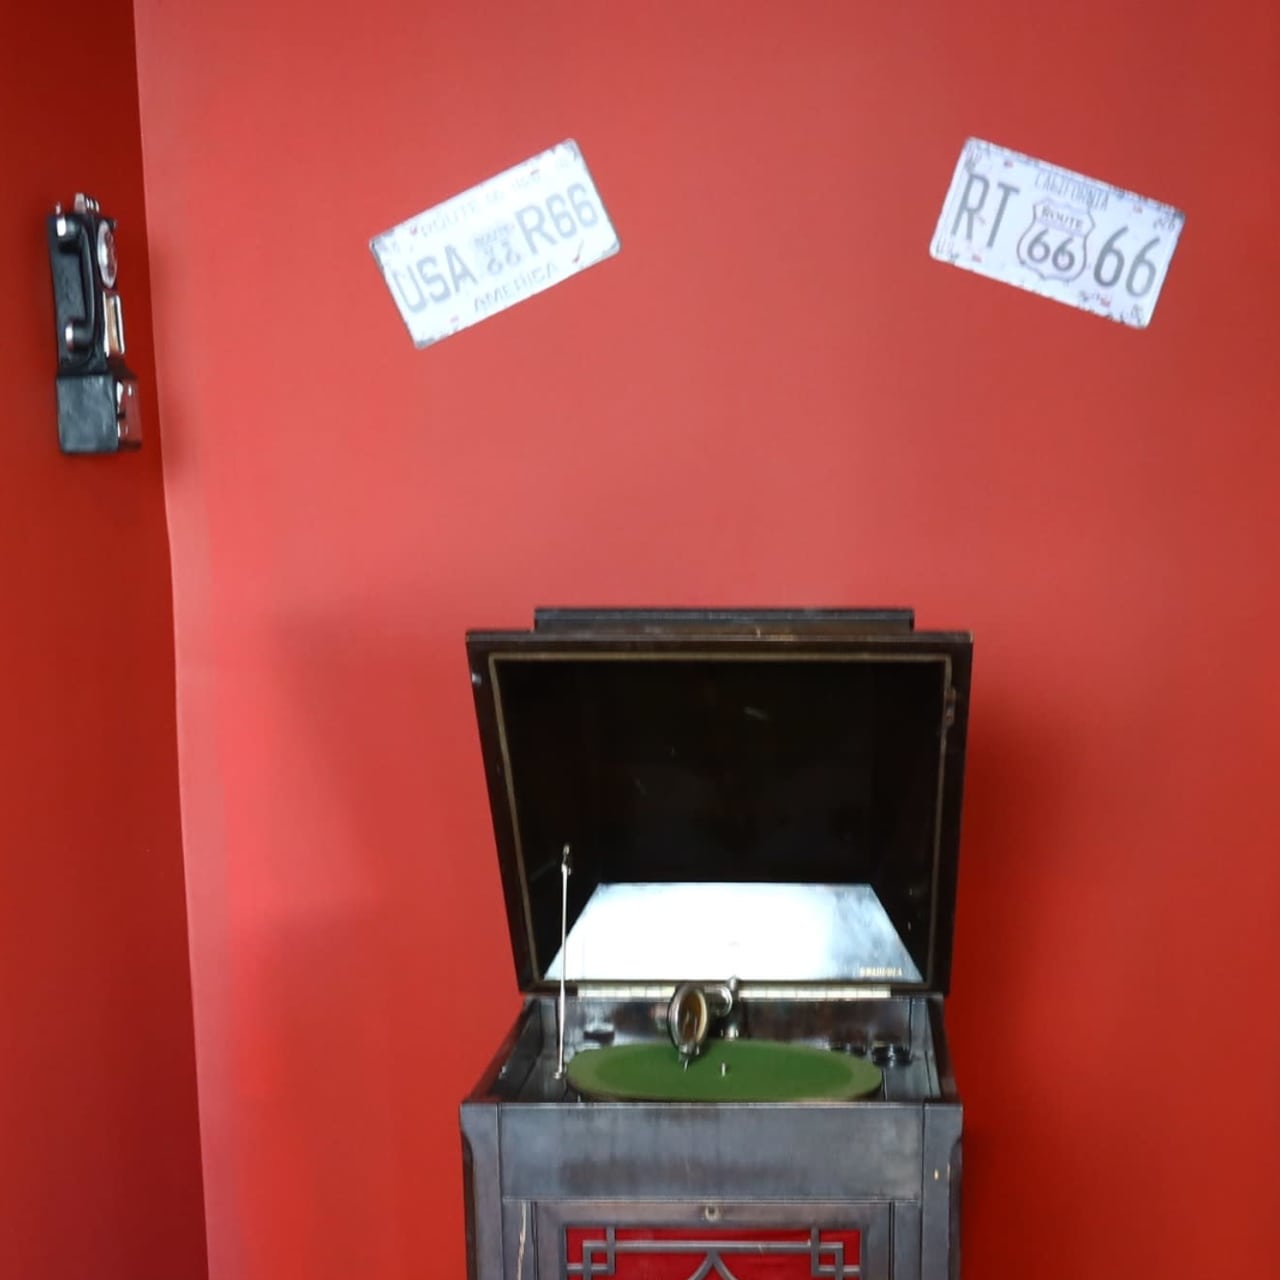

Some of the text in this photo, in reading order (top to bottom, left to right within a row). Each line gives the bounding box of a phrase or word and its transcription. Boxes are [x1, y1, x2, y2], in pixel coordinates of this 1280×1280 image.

[391, 182, 600, 315] USA R66
[950, 172, 1161, 298] RT 66
[1027, 228, 1076, 272] 66
[1041, 204, 1085, 230] ROUTE
